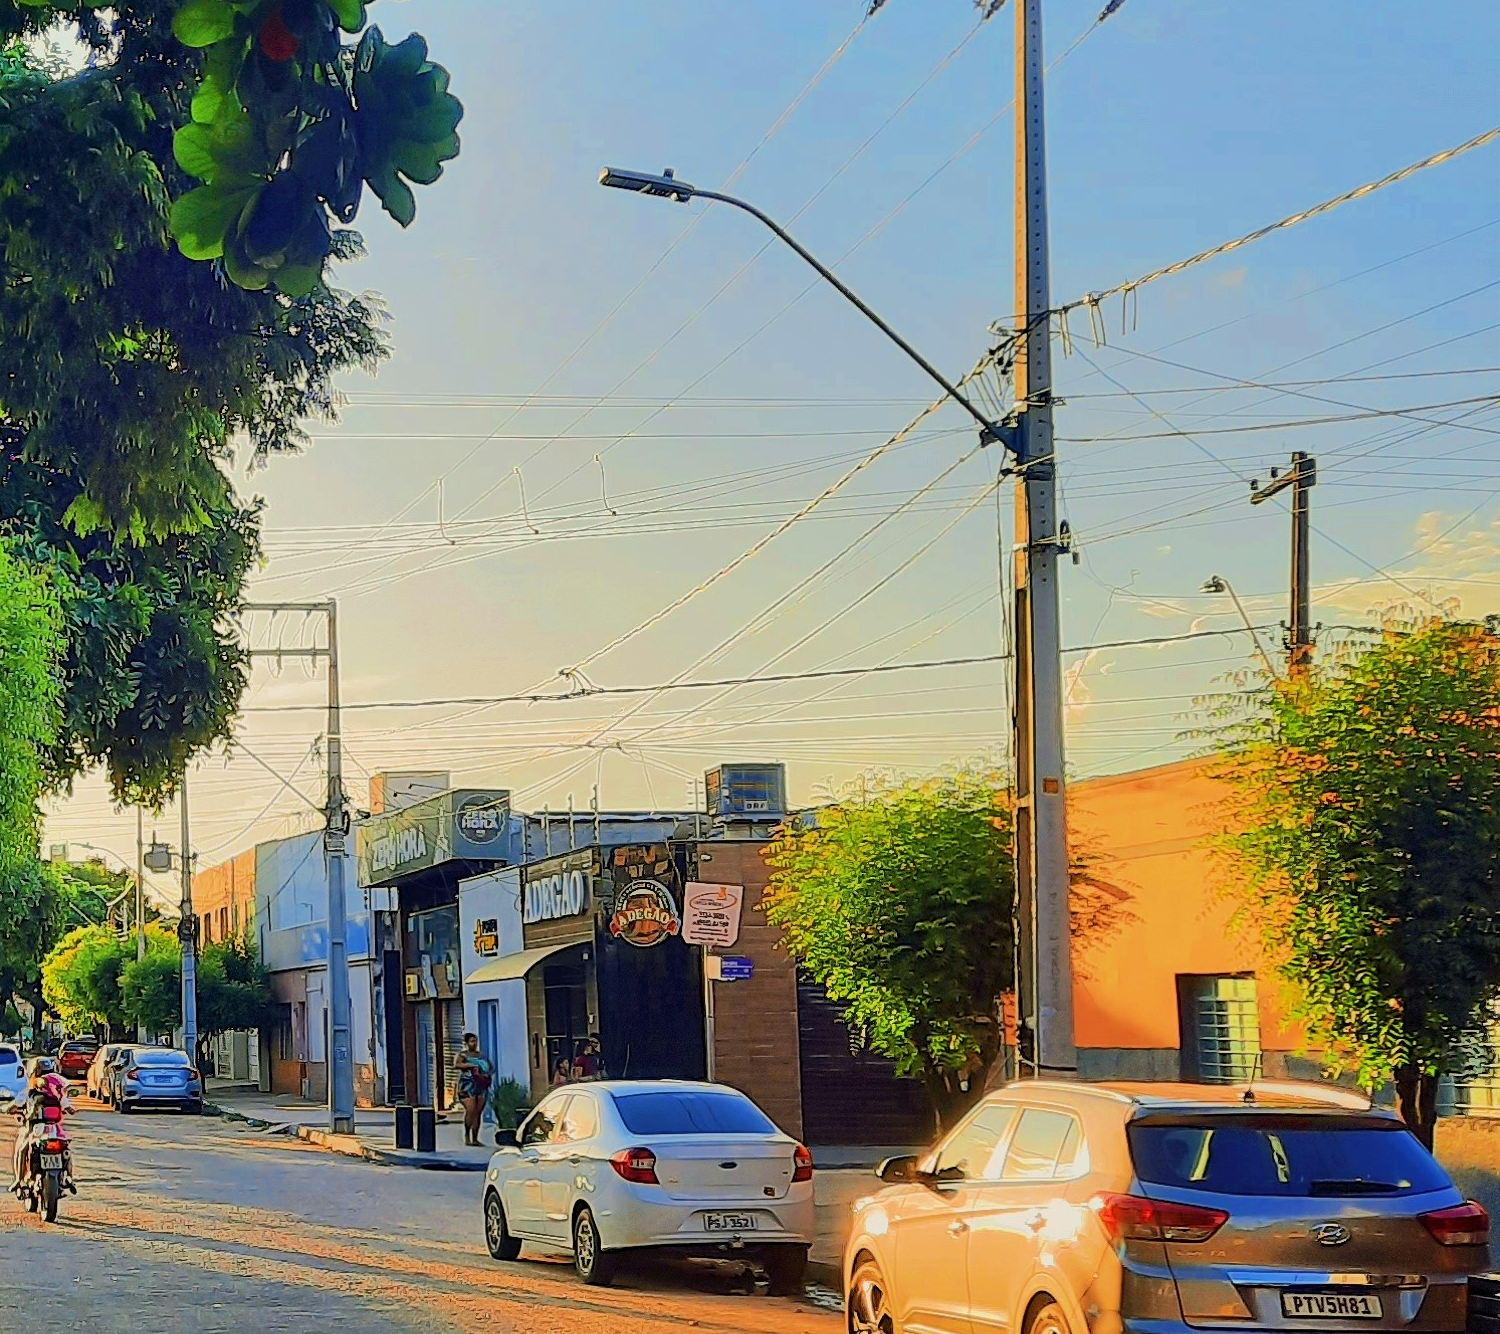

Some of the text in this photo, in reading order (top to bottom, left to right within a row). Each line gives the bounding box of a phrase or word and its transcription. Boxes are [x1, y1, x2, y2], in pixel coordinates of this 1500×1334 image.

[462, 819, 499, 829] HORA
[396, 823, 428, 865] HORA
[1293, 1296, 1373, 1315] PTV5H81
